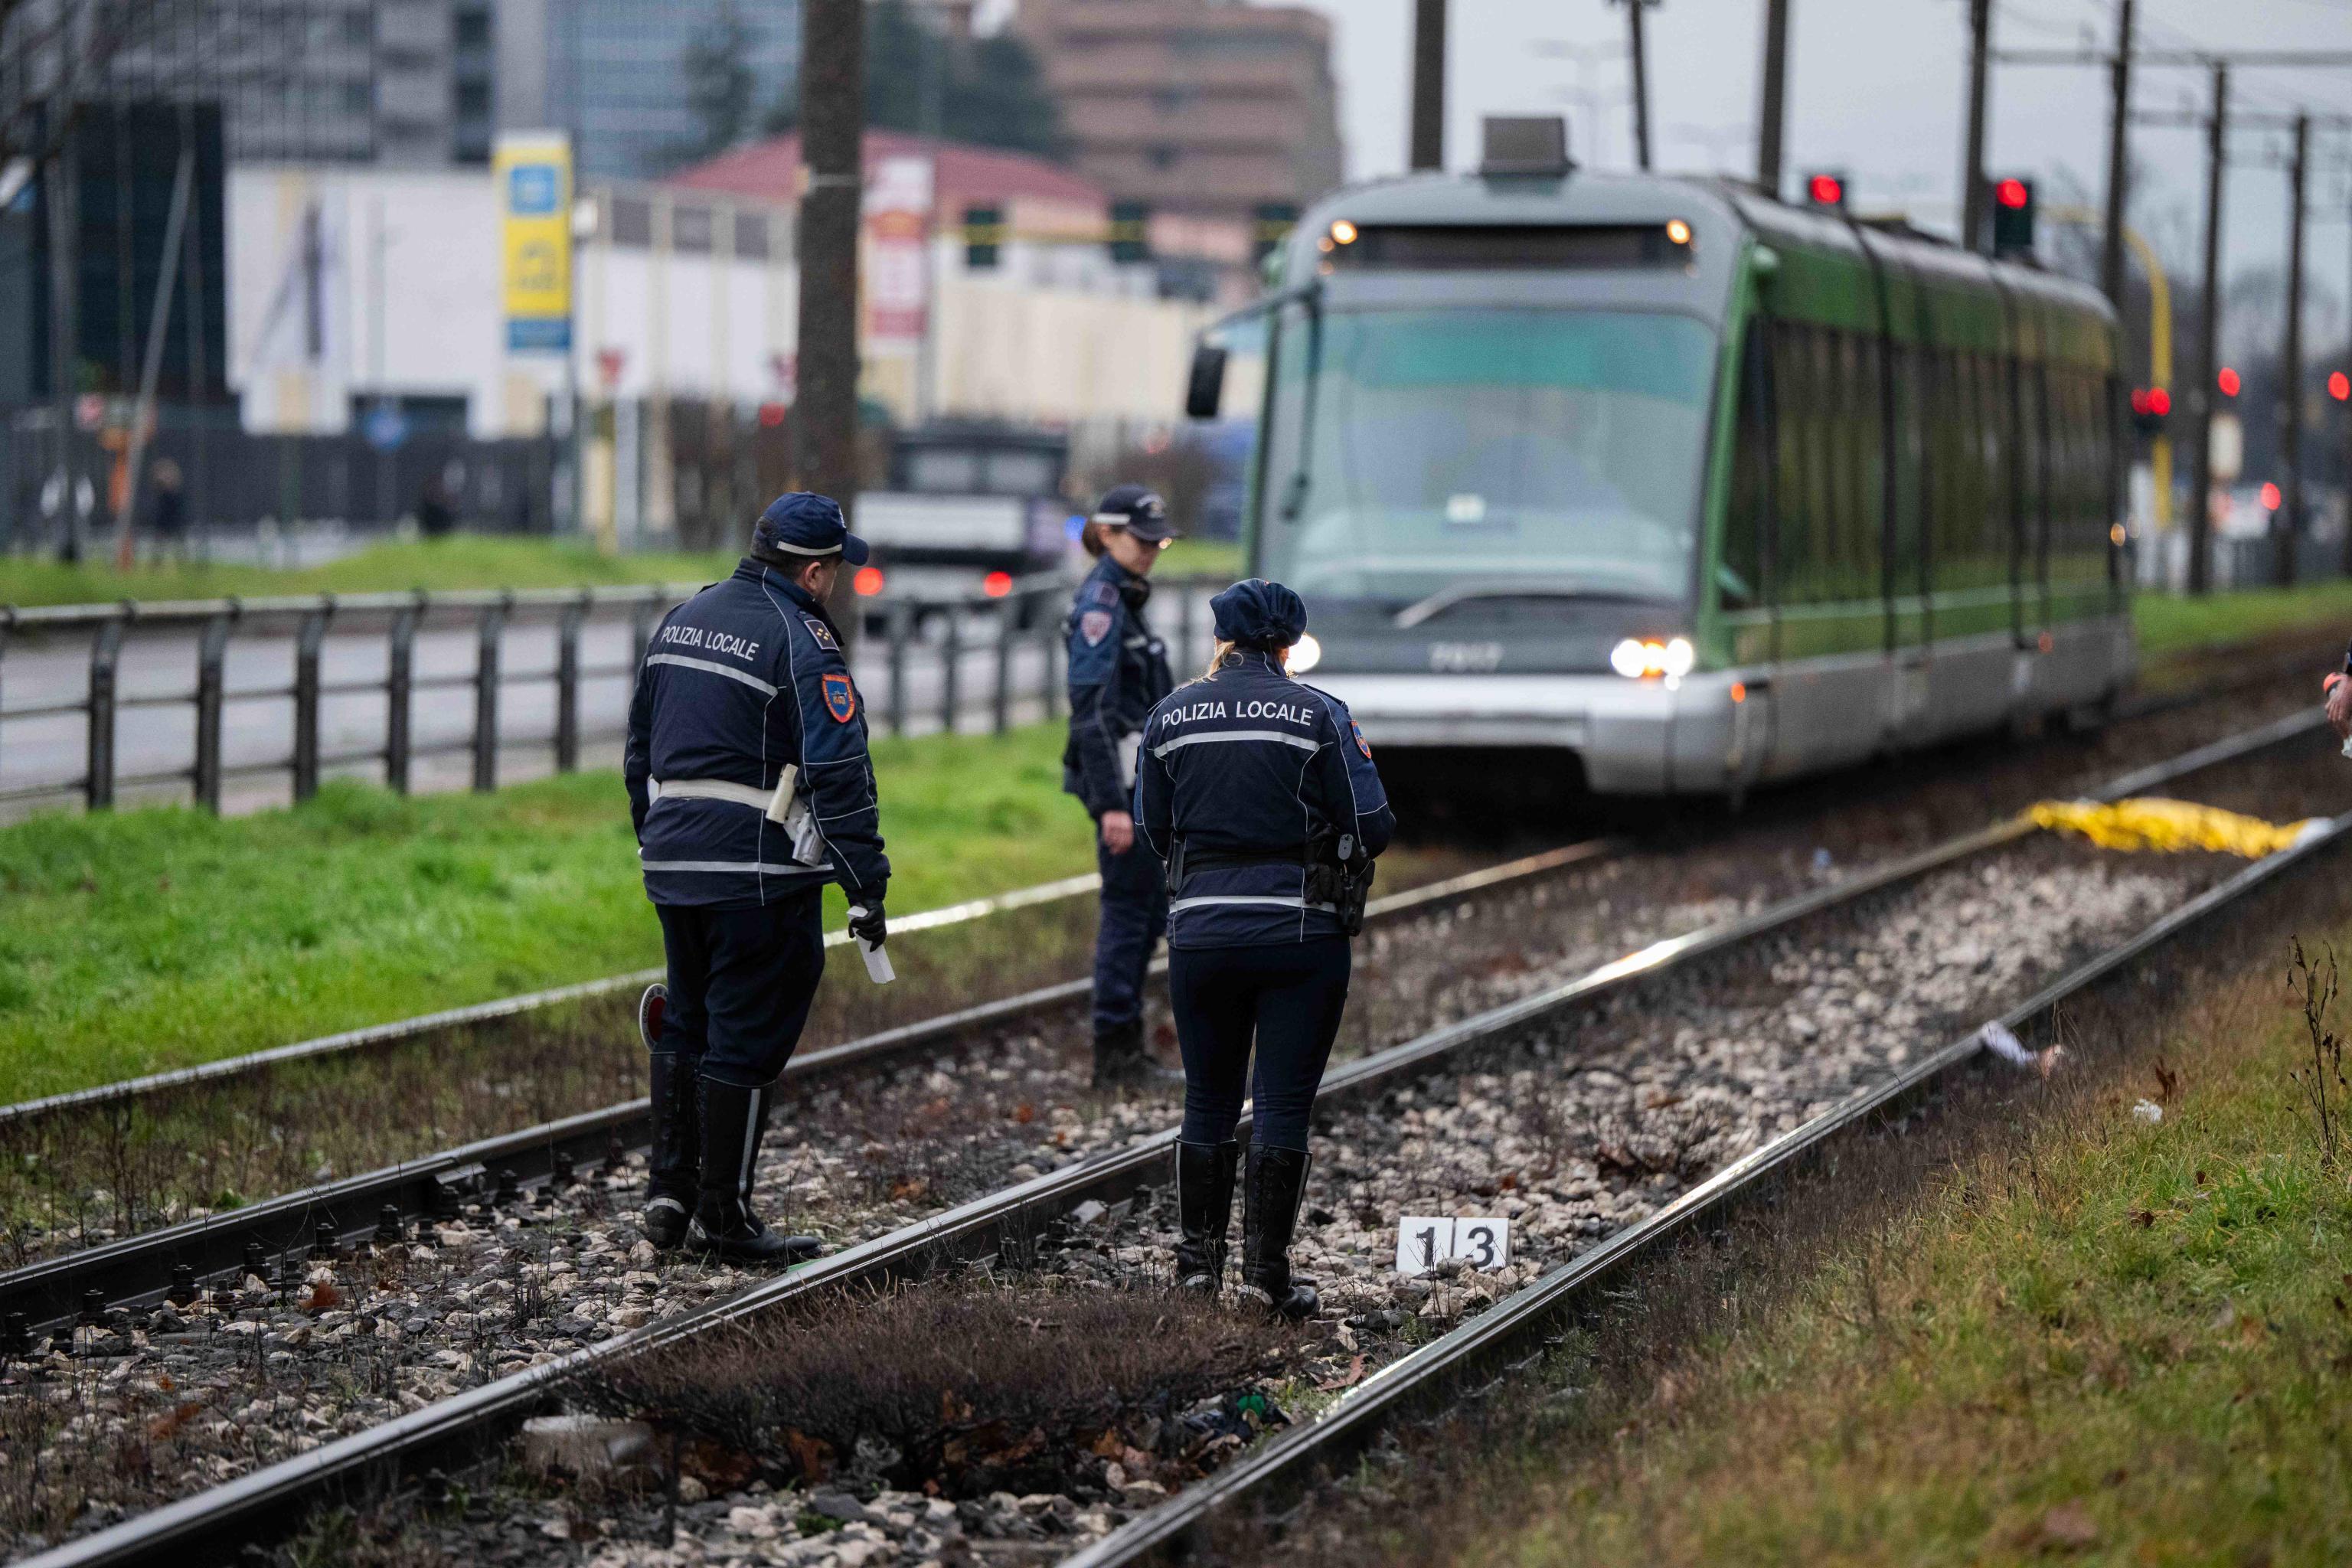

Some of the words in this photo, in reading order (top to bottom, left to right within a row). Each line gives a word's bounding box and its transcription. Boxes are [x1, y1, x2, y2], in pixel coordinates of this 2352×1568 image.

[660, 626, 704, 647] POLIZIA
[704, 630, 760, 662] LOCALE
[1162, 701, 1227, 729] POLIZIA
[1235, 700, 1314, 727] LOCALE
